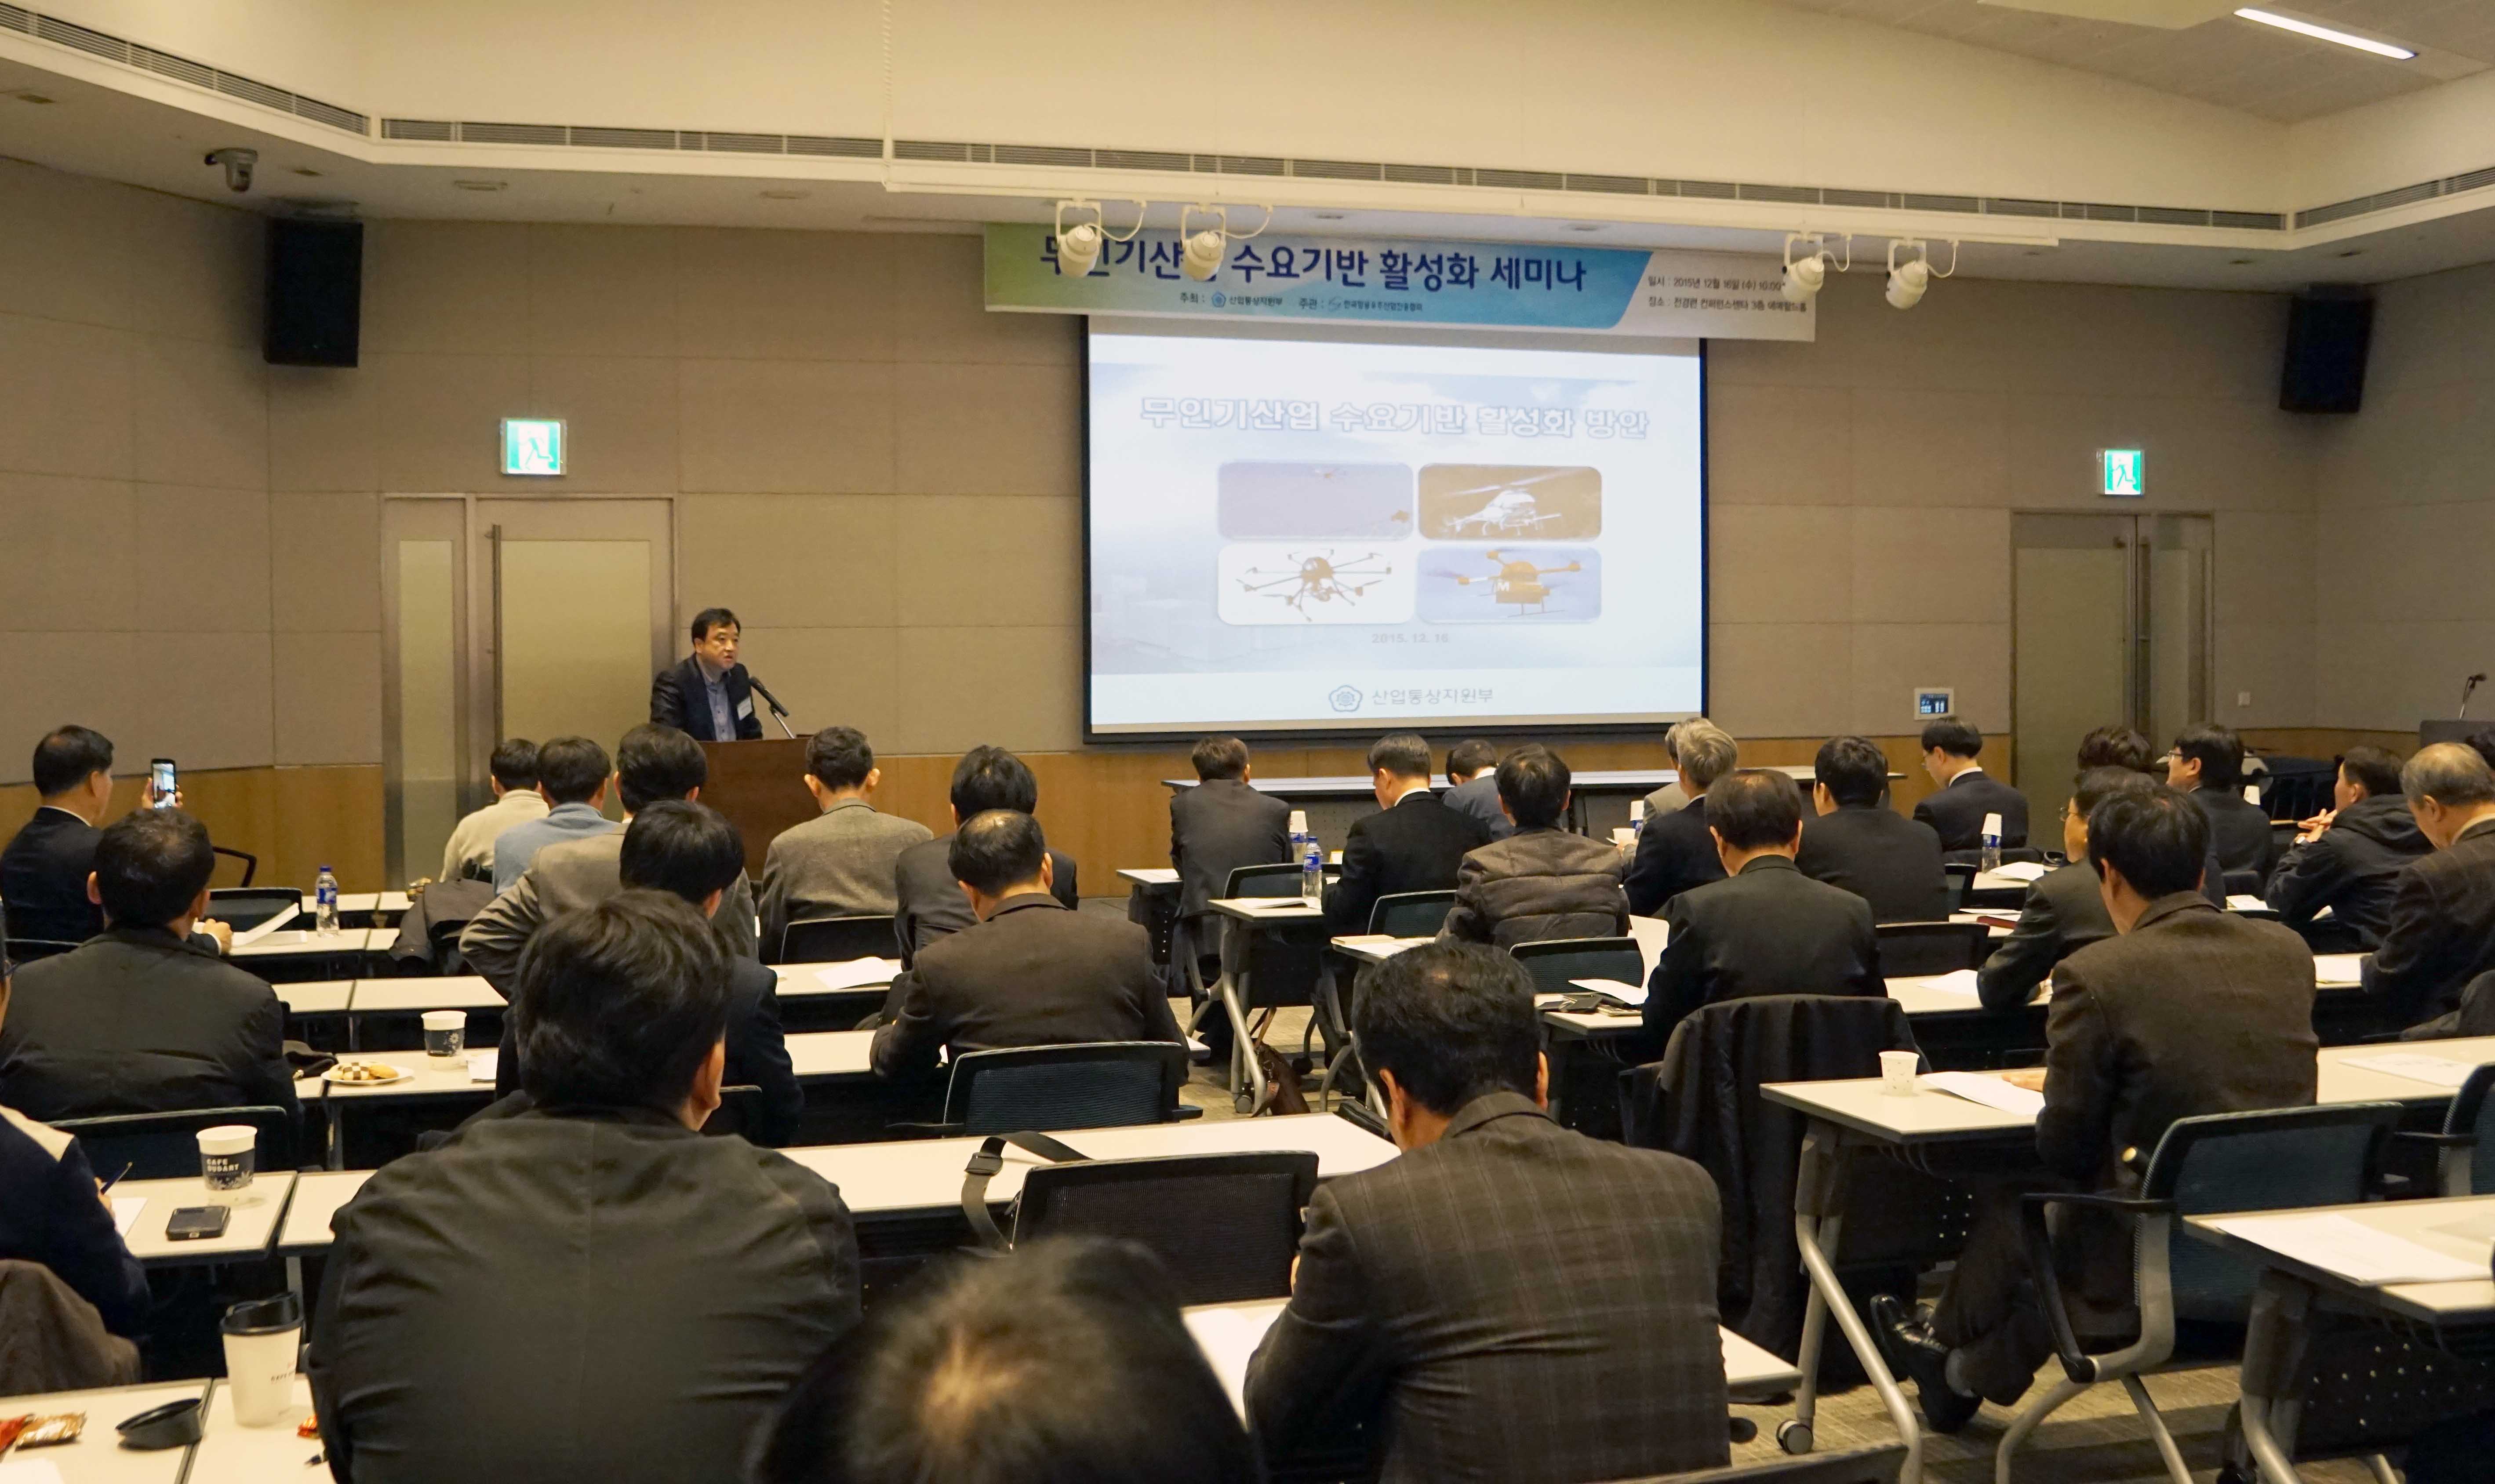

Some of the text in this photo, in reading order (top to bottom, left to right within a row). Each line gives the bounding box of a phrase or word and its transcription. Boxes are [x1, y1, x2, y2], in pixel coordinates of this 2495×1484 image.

[1230, 244, 1369, 288] 수요기반
[1379, 250, 1479, 293] 활성화
[1490, 257, 1586, 292] 세미나
[1648, 276, 1665, 287] 일시
[1673, 277, 1700, 288] 2015년
[1704, 278, 1720, 289] 12월
[1742, 280, 1757, 291] (수)
[1180, 292, 1198, 304] 주최
[1299, 298, 1317, 310] 주관
[1649, 296, 1664, 307] 장소
[1140, 397, 1650, 440] 무인기산업 수요기반 활성화 방안
[1371, 633, 1407, 644] 2015.
[1435, 633, 1449, 643] 16
[1372, 687, 1494, 705] 산업통상자원부
